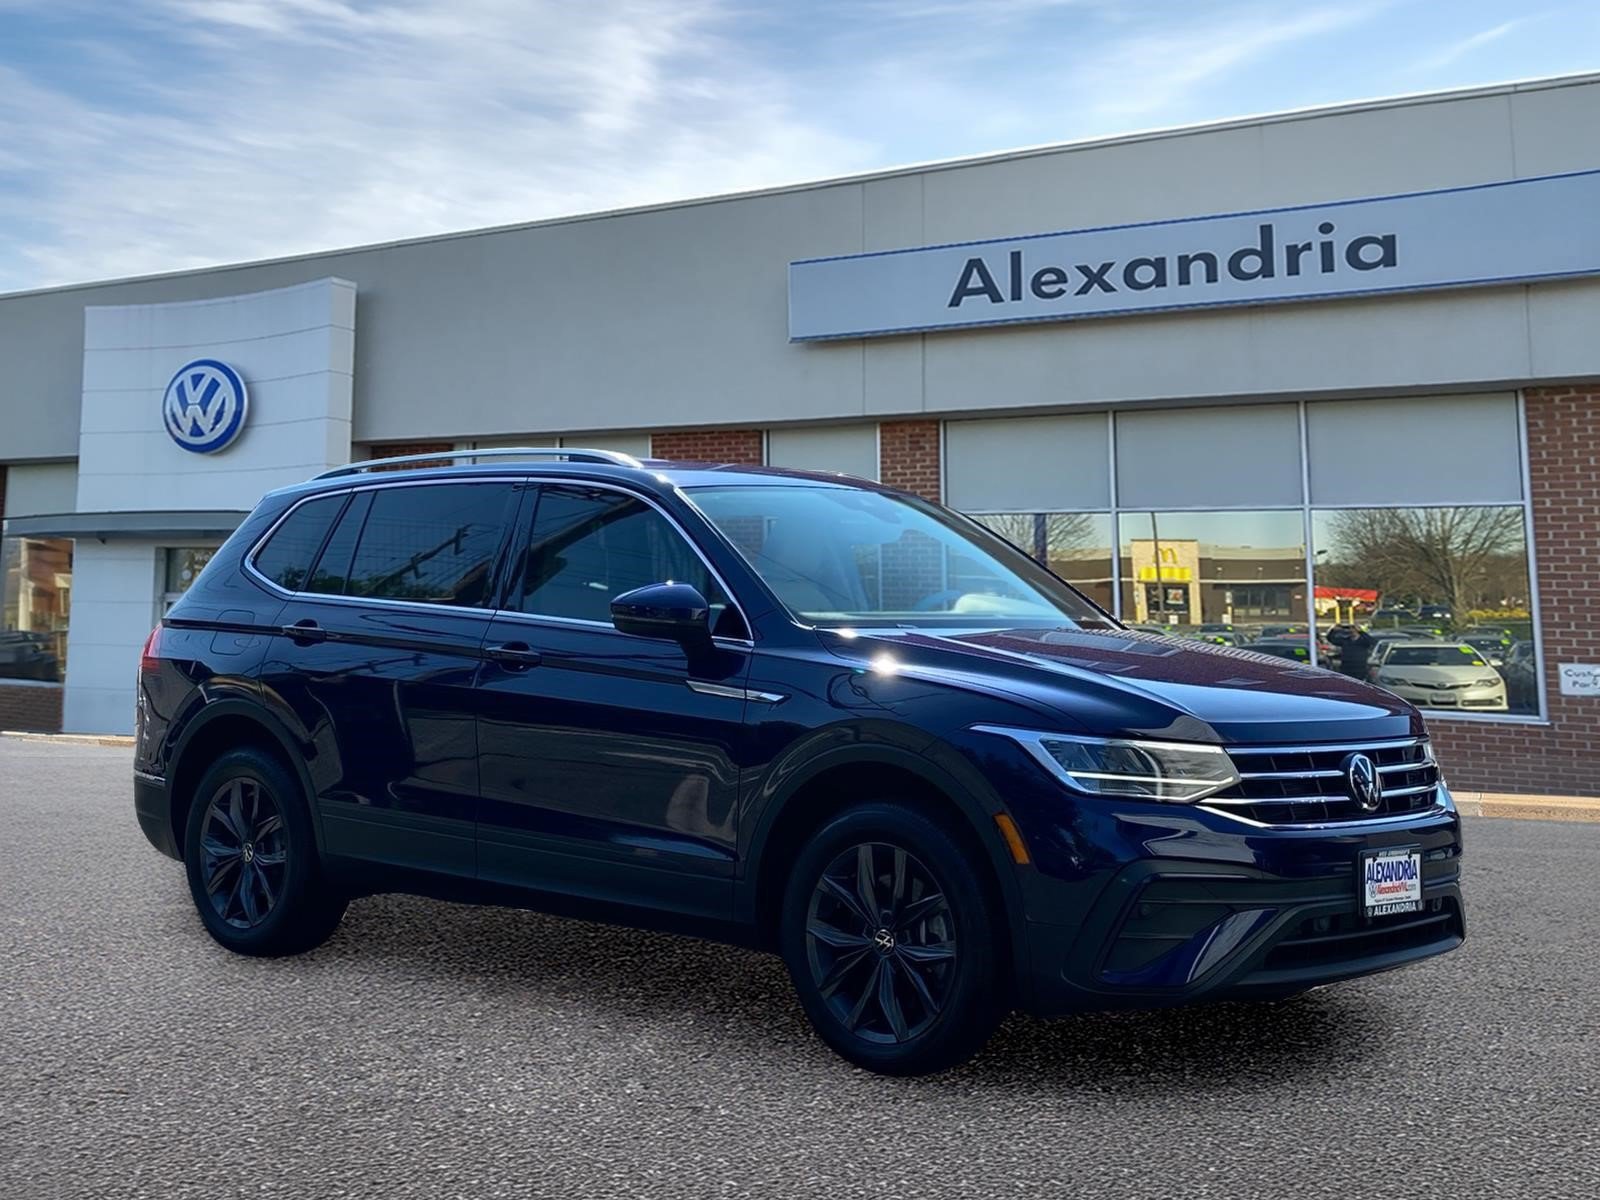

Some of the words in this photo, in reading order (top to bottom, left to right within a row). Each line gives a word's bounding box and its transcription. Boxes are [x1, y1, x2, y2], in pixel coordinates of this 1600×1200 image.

[948, 222, 1397, 308] Alexandria
[1366, 859, 1418, 884] ALEXANDRIA
[1373, 902, 1417, 916] ALEXANDRIA
